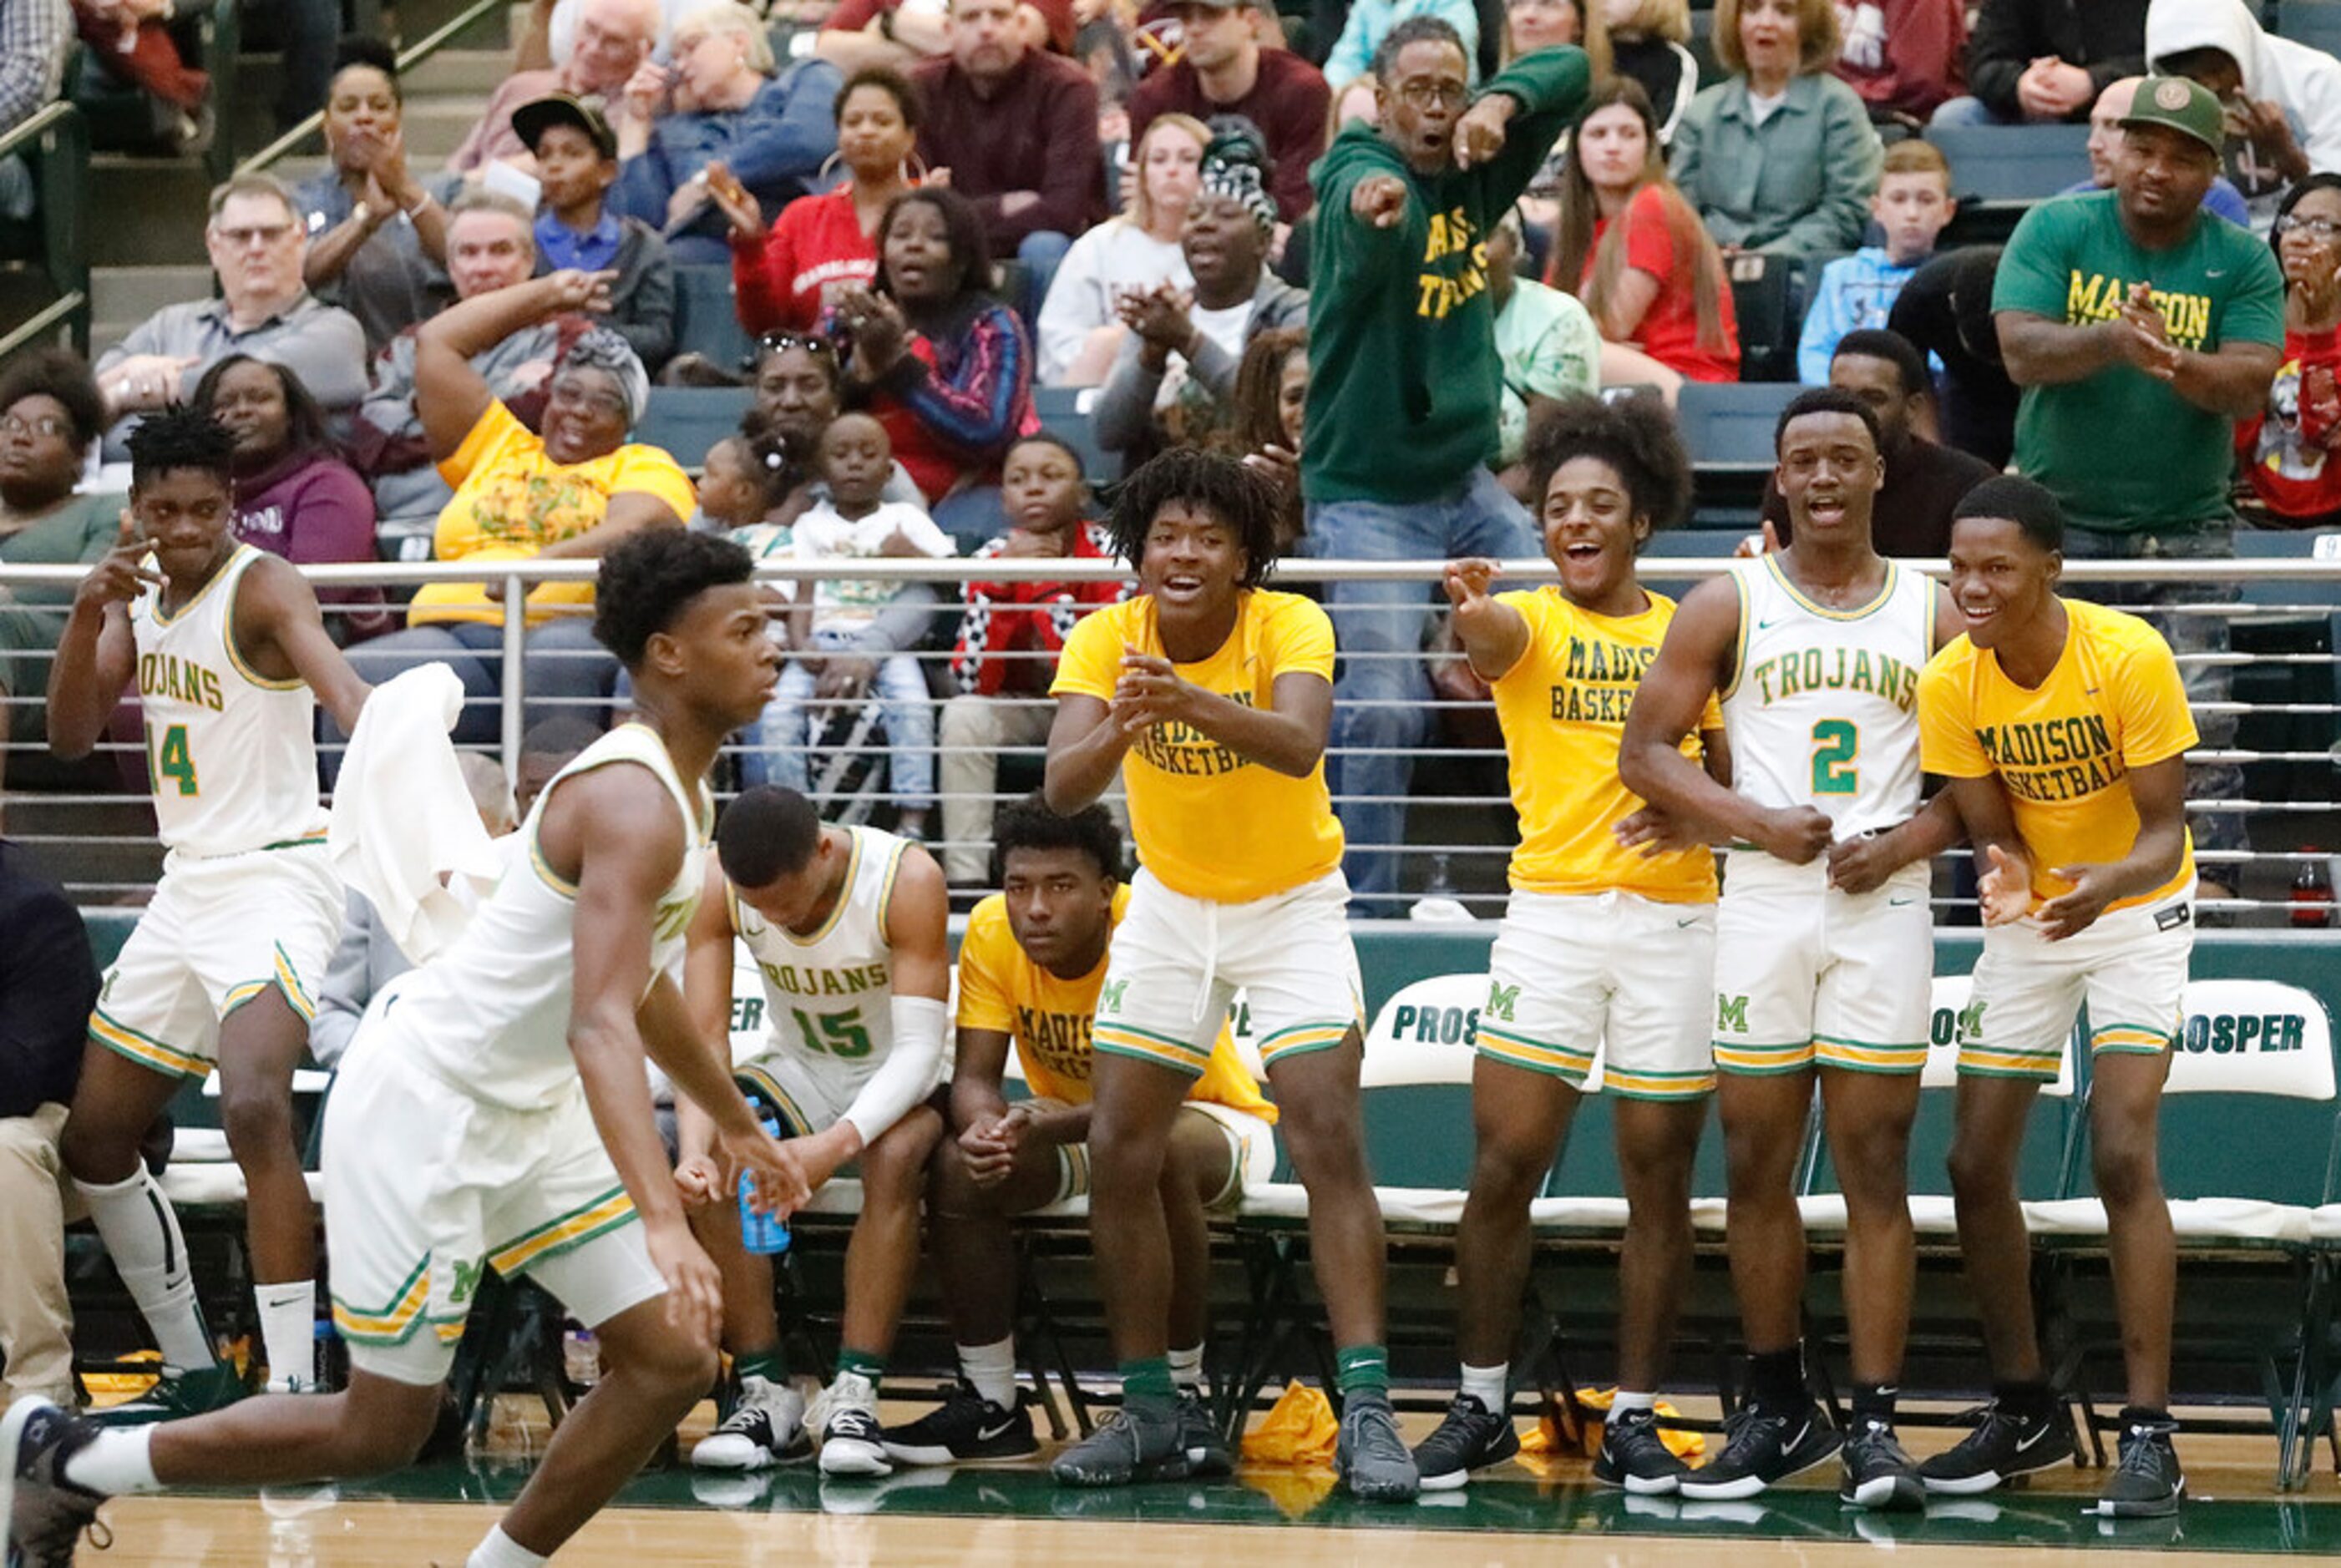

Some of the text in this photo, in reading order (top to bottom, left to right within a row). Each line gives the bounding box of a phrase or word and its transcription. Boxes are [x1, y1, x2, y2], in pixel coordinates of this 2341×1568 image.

[1754, 647, 1918, 713] TROJANS
[1811, 717, 1859, 797] 2
[1975, 715, 2113, 766] MADISON
[1485, 980, 1522, 1023] M
[1718, 993, 1751, 1034] M
[790, 1002, 873, 1058] 15
